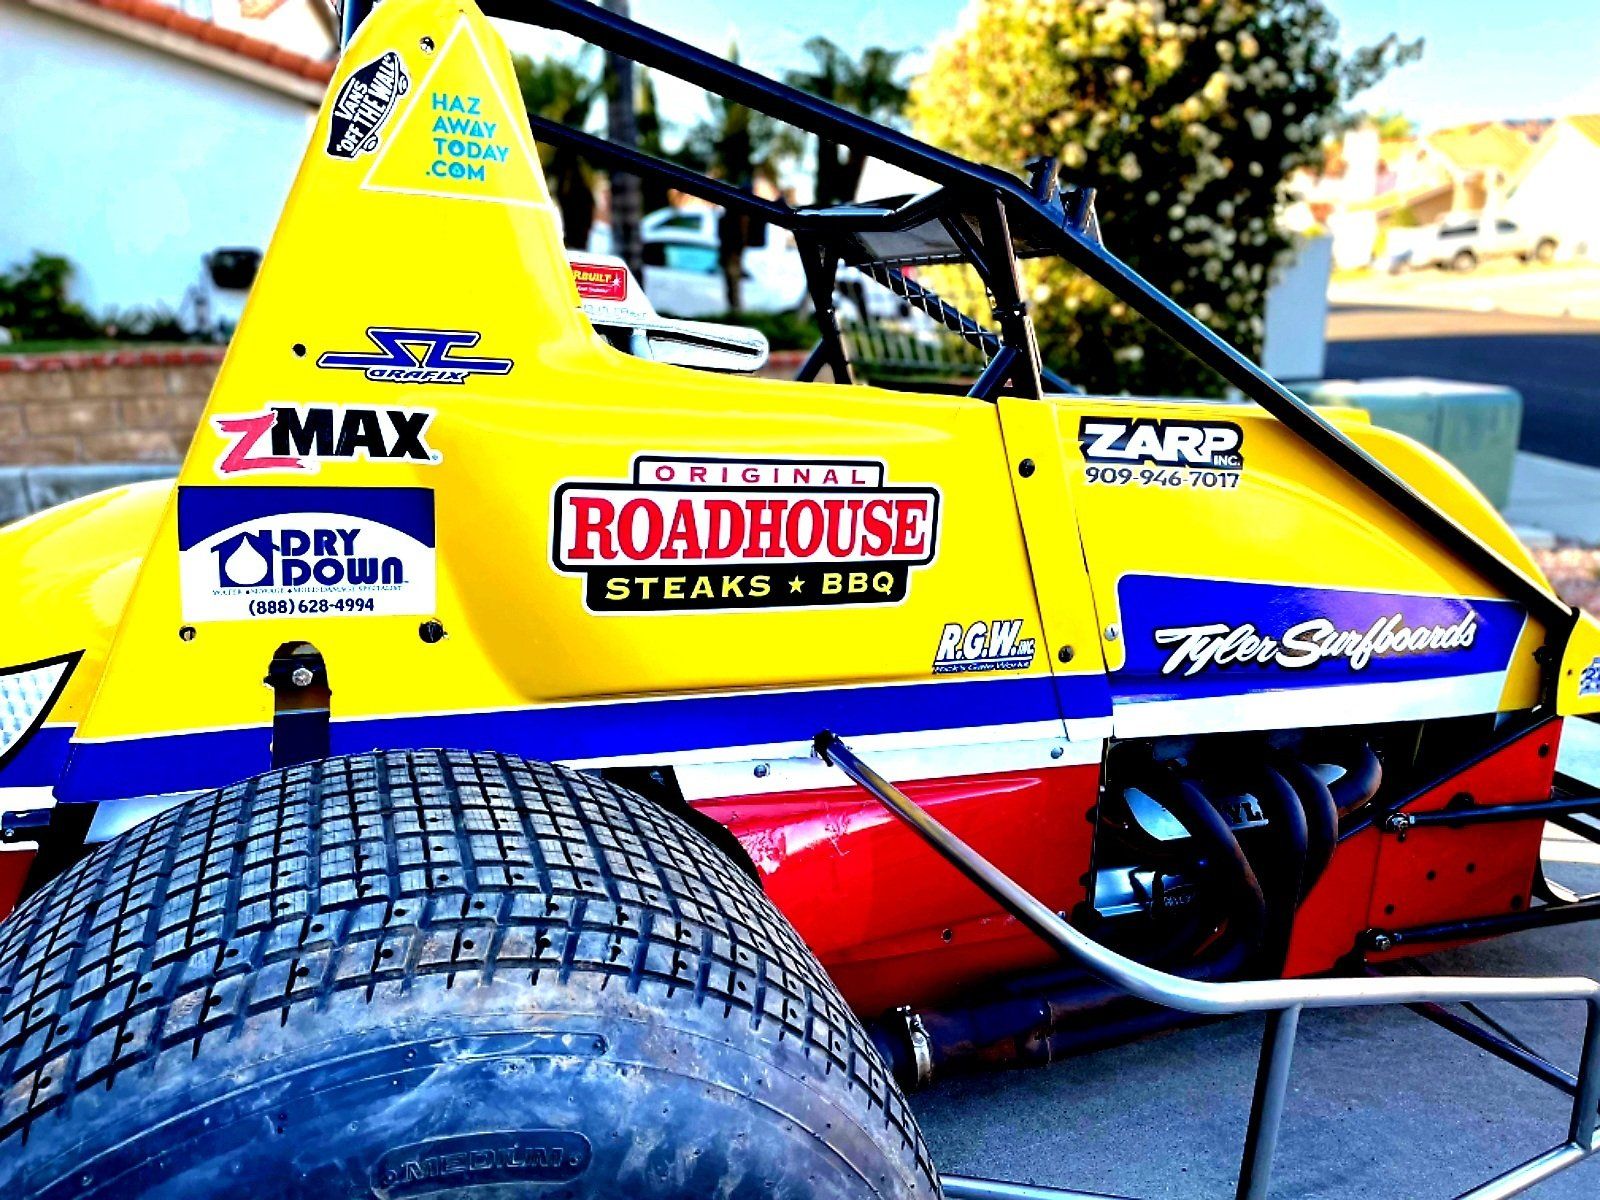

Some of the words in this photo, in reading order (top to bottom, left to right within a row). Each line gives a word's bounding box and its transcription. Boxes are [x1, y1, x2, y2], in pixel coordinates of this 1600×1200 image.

[334, 78, 368, 121] VANS
[353, 95, 386, 128] THE
[432, 92, 481, 115] HAZ
[432, 115, 497, 138] AWAY
[433, 137, 509, 162] TODAY
[426, 160, 485, 181] .COM
[573, 270, 612, 283] RBUILT
[369, 369, 464, 381] GRAFIX
[1084, 423, 1239, 463] ZARP
[1213, 454, 1241, 466] INC.
[655, 465, 866, 485] ORIGINAL
[1085, 466, 1240, 488] 909-946-7017
[280, 528, 361, 557] DRY
[567, 496, 928, 560] ROADHOUSE
[282, 556, 404, 586] DOWN
[605, 575, 771, 600] STEAKS
[821, 571, 895, 596] BBQ
[935, 619, 1023, 661] R.G.W.
[1155, 623, 1277, 676] Tyler
[1275, 611, 1477, 670] Surfboards
